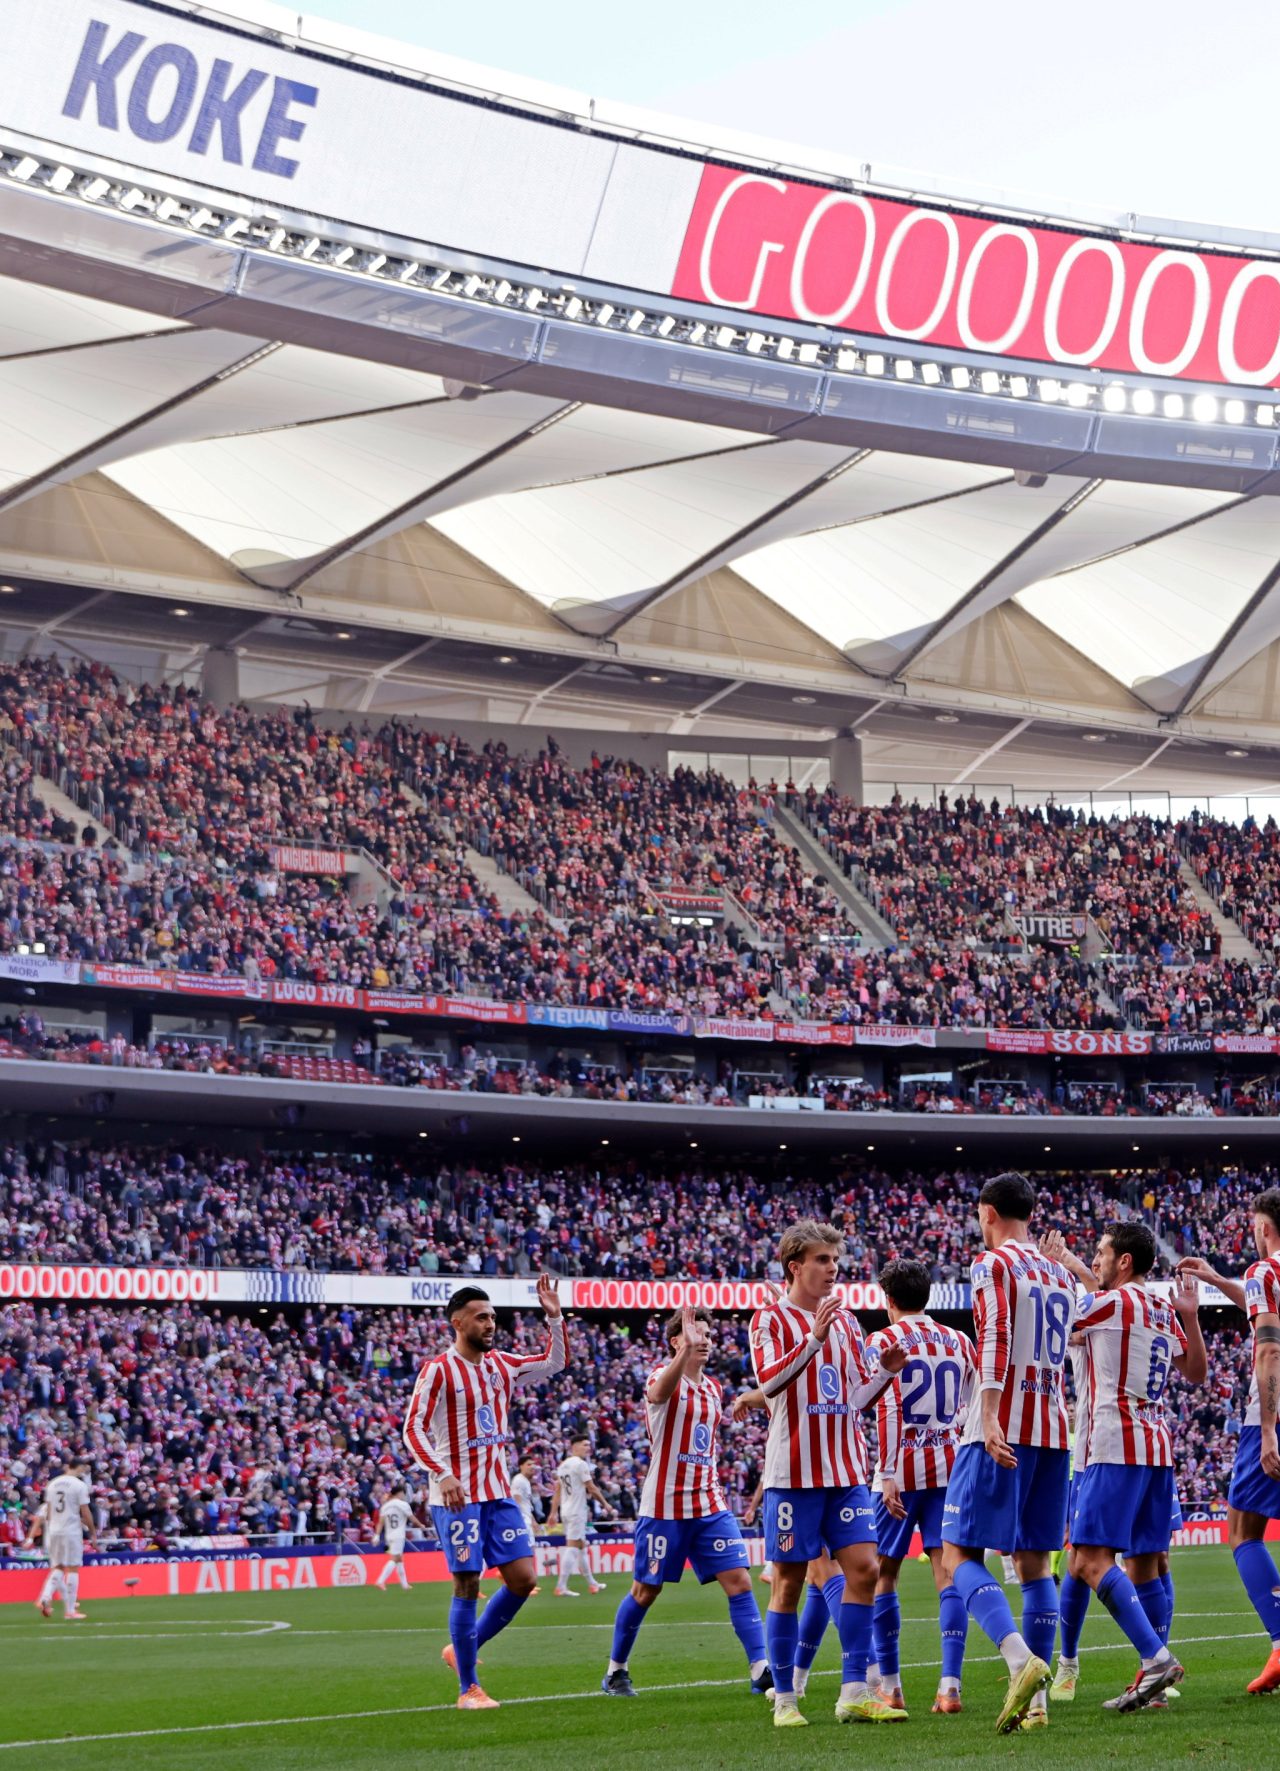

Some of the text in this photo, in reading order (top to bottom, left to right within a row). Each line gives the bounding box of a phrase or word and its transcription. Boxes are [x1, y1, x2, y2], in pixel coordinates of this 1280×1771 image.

[62, 19, 320, 180] KOKE
[282, 846, 342, 873] MIGUELTURRA
[8, 966, 39, 977] MORA
[274, 982, 317, 1000] LUGO
[321, 986, 355, 1004] 1978
[369, 1000, 401, 1008] ANTONIO
[547, 1006, 609, 1027] TETUAN
[611, 1011, 672, 1027] CANDELEDA
[710, 1022, 771, 1038] Piedrabuena
[859, 1026, 887, 1037] DIEGO
[1051, 1032, 1147, 1053] SONS
[1168, 1036, 1211, 1051] 17 MAYO
[411, 1282, 453, 1300] KOKE
[1028, 1286, 1069, 1365] 18
[901, 1330, 959, 1351] GIULIANO
[1147, 1336, 1169, 1401] 6
[901, 1359, 961, 1424] 20
[809, 1404, 838, 1414] RIYADH
[468, 1436, 495, 1447] RIYADH
[678, 1453, 706, 1465] RIYADH
[56, 1491, 66, 1513] 3
[387, 1513, 400, 1528] 16
[777, 1501, 793, 1531] 8
[450, 1518, 480, 1546] 23
[646, 1533, 668, 1560] 19
[338, 1562, 359, 1577] EA
